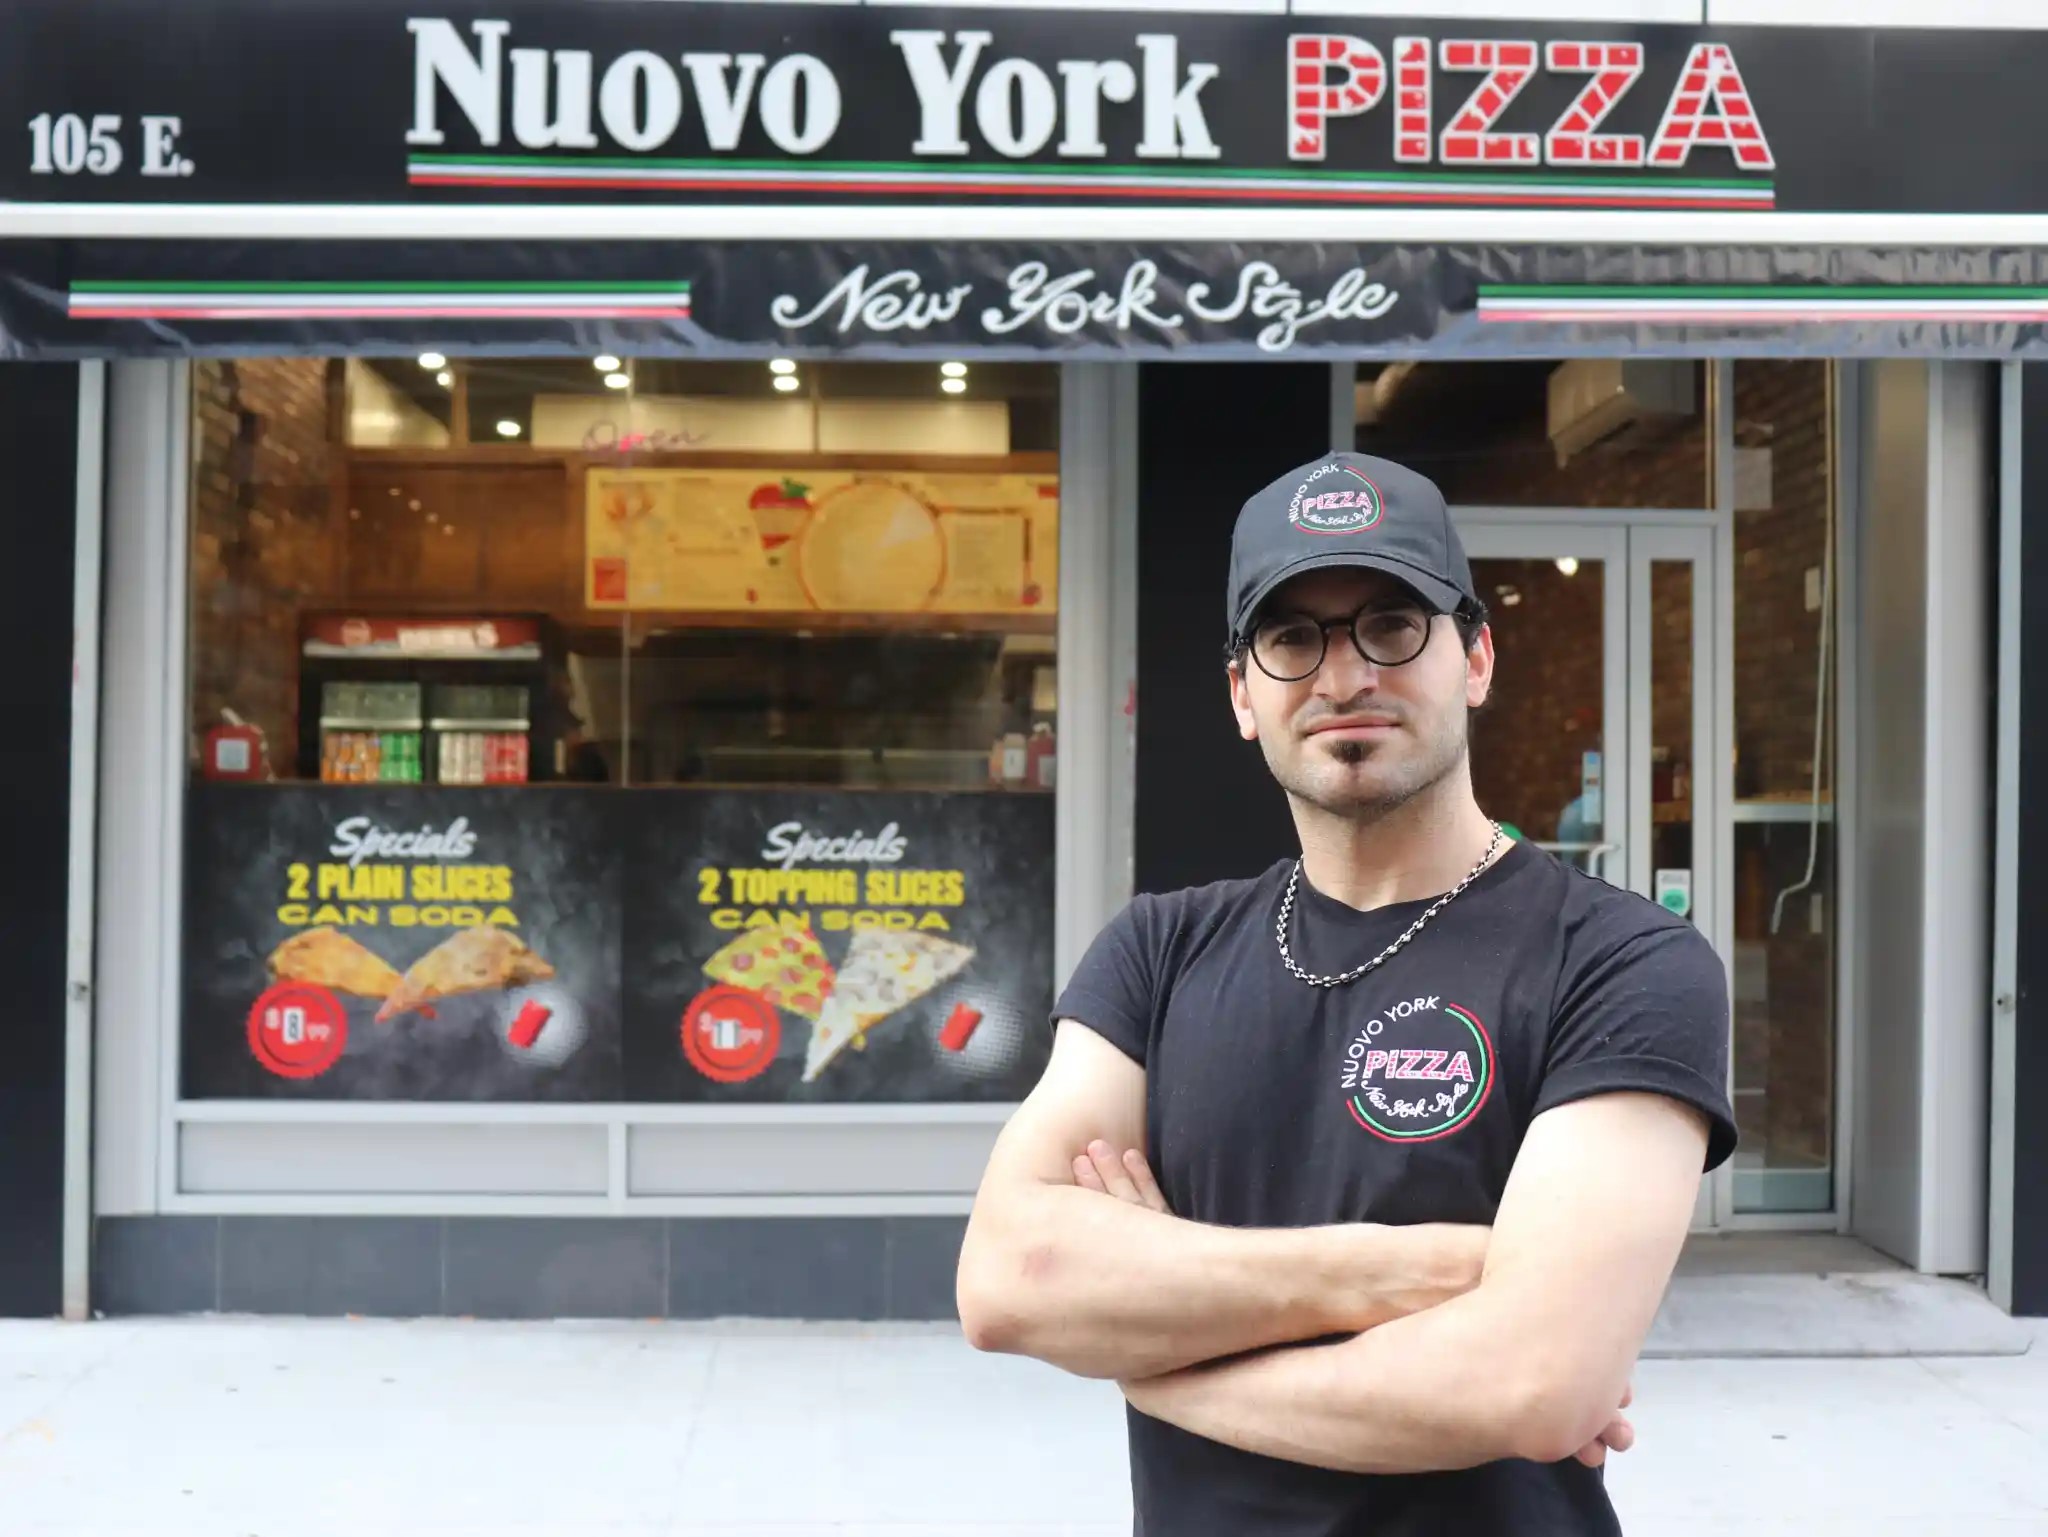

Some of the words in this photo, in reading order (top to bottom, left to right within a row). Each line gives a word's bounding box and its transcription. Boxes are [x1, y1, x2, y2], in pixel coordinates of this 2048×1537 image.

[406, 17, 841, 154] Nuovo
[891, 29, 1220, 159] York
[1287, 34, 1777, 172] PIZZA
[29, 113, 122, 175] 105
[141, 116, 195, 177] E.
[771, 264, 972, 332] New
[982, 259, 1182, 332] York
[1187, 260, 1397, 352] Style
[1288, 484, 1308, 523] NUOVO
[1306, 463, 1340, 482] YORK
[1302, 491, 1372, 517] PIZZA
[330, 816, 478, 867] Specials
[761, 821, 908, 870] Specials
[287, 863, 311, 901] 2
[317, 863, 405, 901] PLAIN
[411, 865, 514, 901] SLICES
[698, 869, 721, 904] 2
[728, 870, 858, 905] TOPPING
[866, 870, 965, 906] SLICES
[277, 905, 379, 926] CAN
[389, 906, 520, 927] SODA
[709, 908, 810, 930] CAN
[821, 909, 950, 931] SODA
[1341, 1020, 1384, 1088] NUOVO
[1384, 995, 1440, 1022] YORK
[1362, 1049, 1475, 1082] PIZZA
